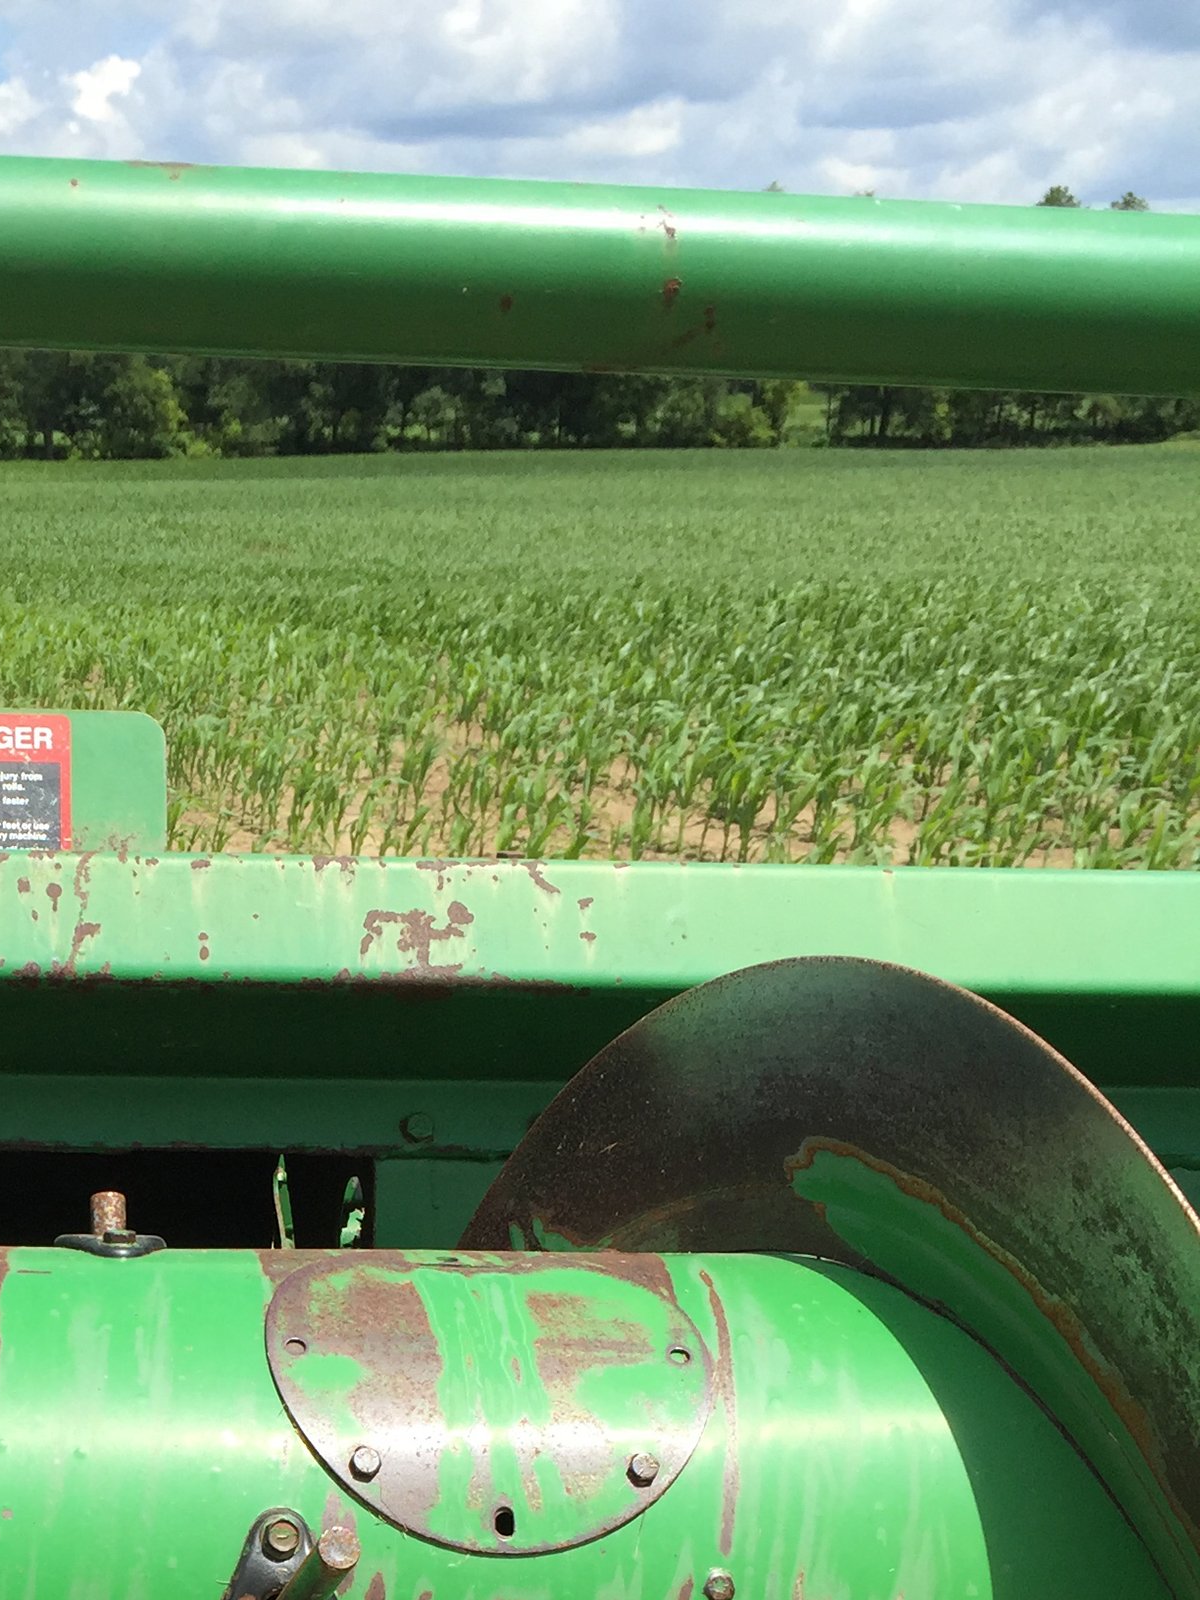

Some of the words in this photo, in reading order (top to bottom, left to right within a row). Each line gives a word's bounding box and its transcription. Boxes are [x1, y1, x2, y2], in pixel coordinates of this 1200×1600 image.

[21, 771, 43, 781] from
[2, 782, 26, 791] rolls.
[2, 796, 29, 805] faster
[2, 820, 20, 830] feet
[21, 822, 32, 830] or
[32, 822, 50, 831] use
[8, 831, 50, 841] machine.
